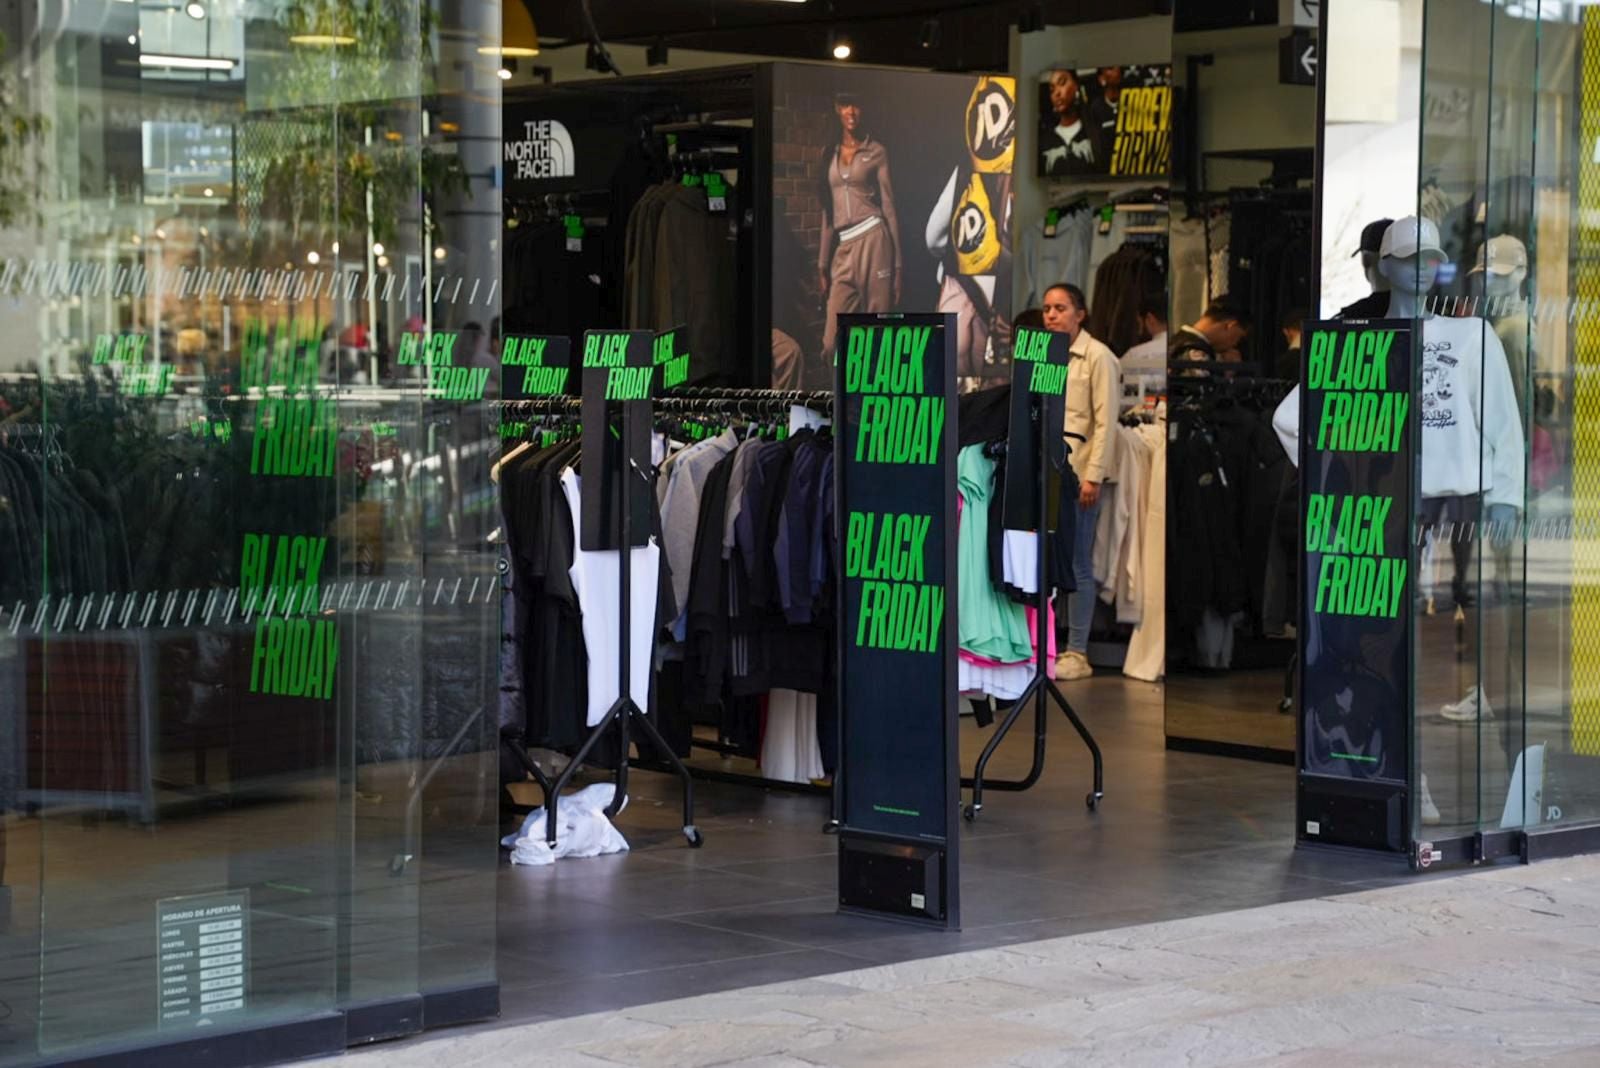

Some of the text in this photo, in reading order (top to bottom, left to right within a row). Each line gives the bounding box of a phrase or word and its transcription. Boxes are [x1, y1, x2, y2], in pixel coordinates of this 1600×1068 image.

[524, 121, 550, 140] THE
[974, 92, 1009, 151] JD
[505, 141, 550, 161] NORTH
[518, 160, 550, 179] FACE
[958, 207, 982, 249] JD
[397, 332, 457, 366] BLACK
[502, 337, 547, 366] BLACK
[583, 334, 630, 368] BLACK
[653, 332, 675, 366] LACK
[846, 326, 931, 394] BLACK
[1014, 329, 1052, 362] BLACK
[1308, 329, 1396, 391] BLACK
[1423, 341, 1451, 352] AS
[427, 366, 491, 400] FRIDAY
[522, 366, 568, 395] FRIDAY
[605, 367, 654, 400] FRIDAY
[1029, 362, 1069, 396] FRIDAY
[856, 396, 945, 465] FRIDAY
[1316, 392, 1409, 453] FRIDAY
[1422, 408, 1453, 421] ALS
[251, 394, 338, 477] FRIDAY
[1306, 493, 1393, 556] BLACK
[846, 511, 932, 582] BLACK
[240, 533, 327, 616] BLACK
[1314, 555, 1408, 618] FRIDAY
[856, 580, 945, 653] FRIDAY
[250, 616, 339, 700] FRIDAY
[1546, 806, 1562, 820] JD
[195, 909, 205, 917] DE
